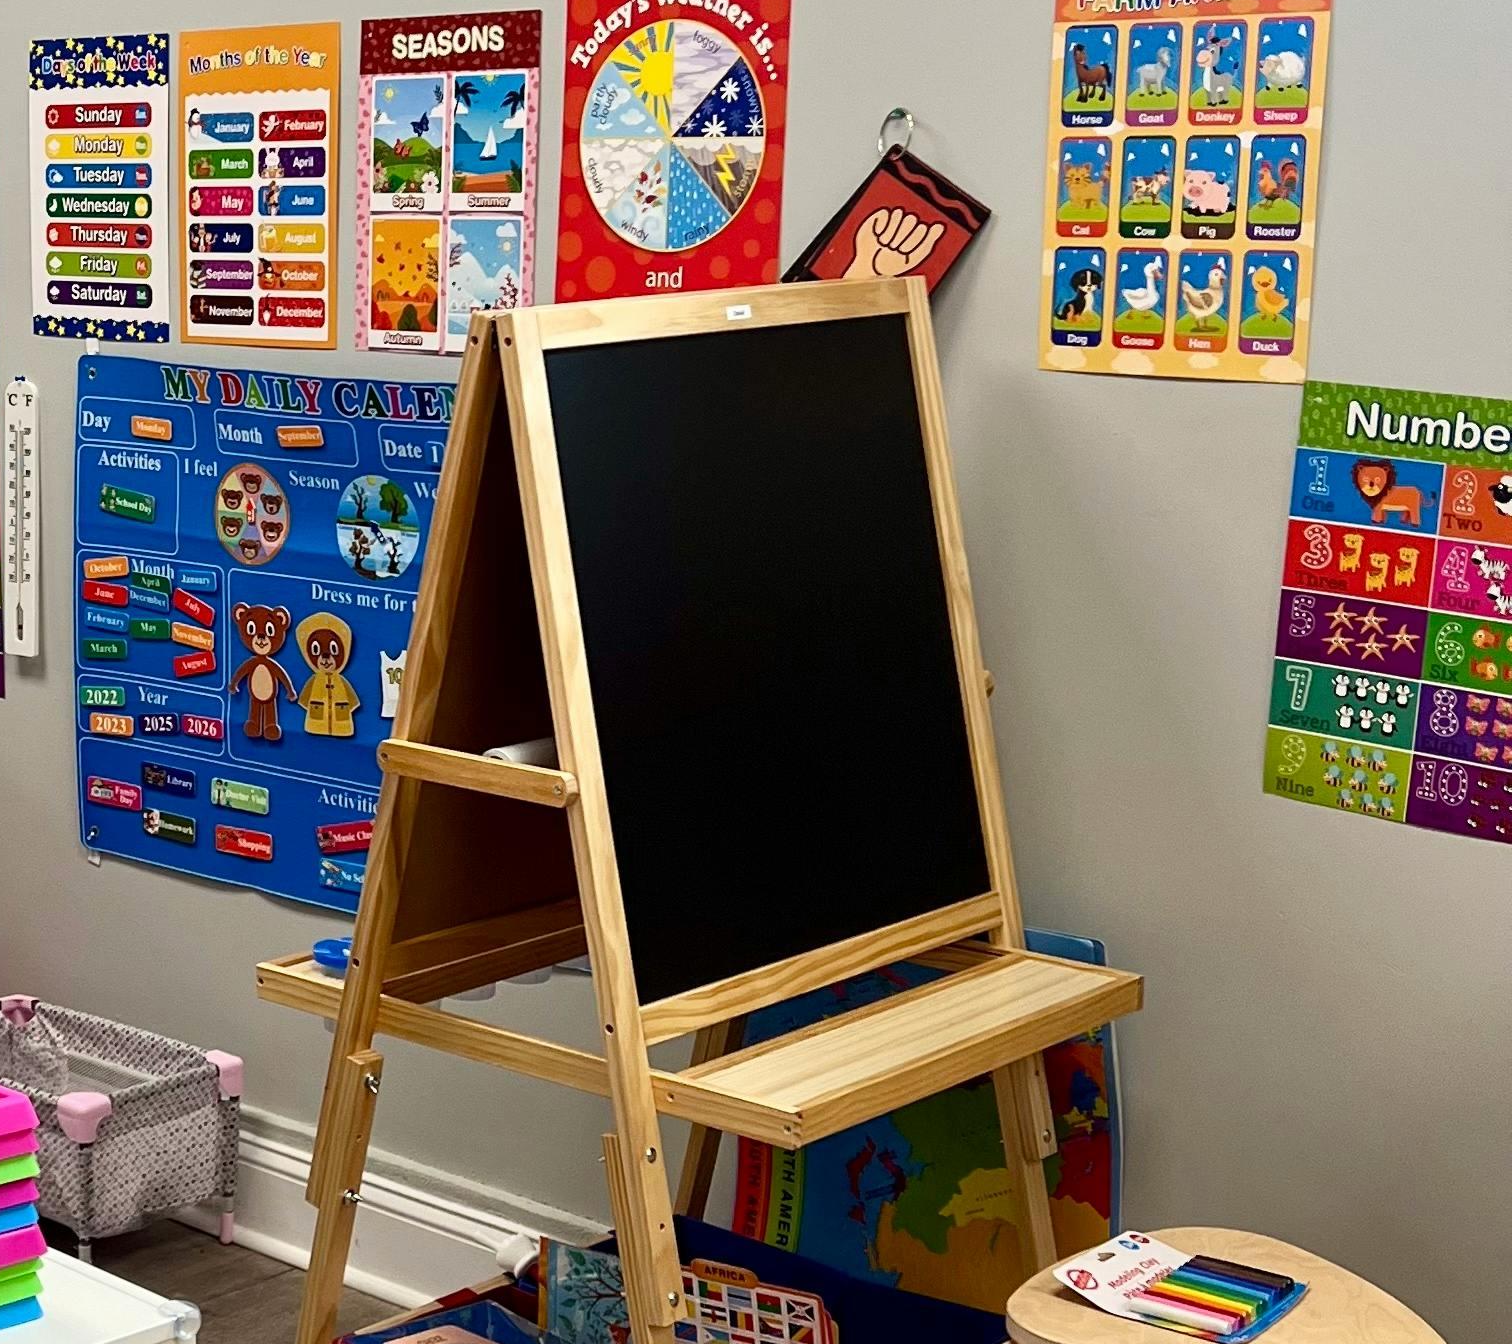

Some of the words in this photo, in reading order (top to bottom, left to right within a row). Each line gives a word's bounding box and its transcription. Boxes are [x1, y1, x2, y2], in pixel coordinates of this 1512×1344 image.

[391, 25, 505, 60] SEASONS
[692, 30, 722, 55] foggy
[41, 55, 76, 77] Days
[117, 50, 157, 72] Week
[189, 50, 241, 76] Months
[244, 45, 261, 66] of
[264, 44, 289, 64] the
[292, 45, 327, 69] Year
[590, 82, 608, 119] partly
[599, 87, 619, 126] cloudy
[75, 106, 122, 125] Sunday
[1071, 113, 1104, 125] Horse
[1138, 112, 1165, 124] Goat
[1195, 111, 1236, 126] Donkey
[1263, 110, 1299, 123] Sheep
[215, 122, 250, 134] January
[284, 120, 324, 132] February
[74, 135, 124, 157] Monday
[221, 159, 248, 169] March
[293, 156, 313, 169] April
[73, 167, 124, 185] Tuesday
[587, 157, 604, 195] cloudy
[62, 197, 129, 216] Wednesday
[222, 195, 244, 211] May
[292, 194, 314, 206] June
[392, 195, 425, 209] Spring
[467, 195, 511, 208] Summer
[70, 225, 128, 246] Thursday
[223, 232, 240, 245] July
[285, 232, 316, 245] August
[619, 218, 650, 243] windy
[683, 222, 712, 242] rainy
[1071, 224, 1091, 236] Cat
[1133, 225, 1157, 237] Cow
[1198, 226, 1216, 239] Pig
[1253, 226, 1297, 238] Rooster
[80, 256, 118, 276] Friday
[206, 269, 253, 281] September
[281, 270, 318, 281] October
[645, 267, 683, 290] and
[71, 284, 127, 305] Saturday
[209, 305, 253, 317] November
[276, 306, 323, 318] December
[383, 332, 424, 346] Autumn
[1120, 335, 1155, 347] Goose
[1188, 338, 1212, 349] Hen
[1252, 340, 1280, 353] Duck
[160, 365, 211, 404] MY
[216, 371, 322, 415] DAILY
[82, 410, 111, 432] Day
[136, 421, 166, 434] Monday
[1346, 399, 1511, 453] Numbe
[217, 423, 263, 445] Month
[278, 430, 321, 442] September
[383, 439, 422, 459] Date
[98, 450, 162, 472] Activities
[185, 458, 189, 474] I
[194, 460, 218, 477] feel
[288, 470, 340, 491] Season
[1309, 456, 1330, 496] 1
[1452, 469, 1478, 515] 2
[115, 497, 137, 508] School
[139, 502, 152, 515] Day
[1301, 496, 1336, 513] One
[1442, 513, 1484, 532] Two
[1300, 524, 1333, 569] 3
[90, 562, 123, 574] October
[131, 558, 175, 579] Month
[1441, 545, 1471, 593] 4
[141, 577, 160, 587] April
[94, 588, 115, 599] June
[311, 583, 352, 605] Dress
[356, 594, 380, 608] me
[384, 594, 408, 612] for
[185, 599, 200, 615] July
[88, 611, 125, 628] February
[1289, 594, 1316, 638] 5
[140, 622, 157, 633] May
[173, 628, 211, 646] November
[1434, 621, 1466, 667] 6
[91, 644, 118, 654] March
[1429, 663, 1459, 683] Six
[86, 690, 118, 704] 2022
[138, 686, 168, 706] Year
[1285, 665, 1313, 712] 7
[1278, 709, 1332, 732] Seven
[1429, 688, 1459, 737] 8
[95, 717, 127, 733] 2023
[143, 716, 173, 731] 2025
[188, 719, 217, 736] 2026
[1277, 733, 1307, 776] 9
[166, 775, 193, 790] Library
[1275, 775, 1316, 798] Nine
[1416, 760, 1469, 806] 10
[115, 786, 138, 799] Family
[119, 796, 133, 806] Day
[776, 1189, 794, 1247] AMER
[1139, 1257, 1161, 1269] Clay
[704, 1266, 746, 1282] AFRICA
